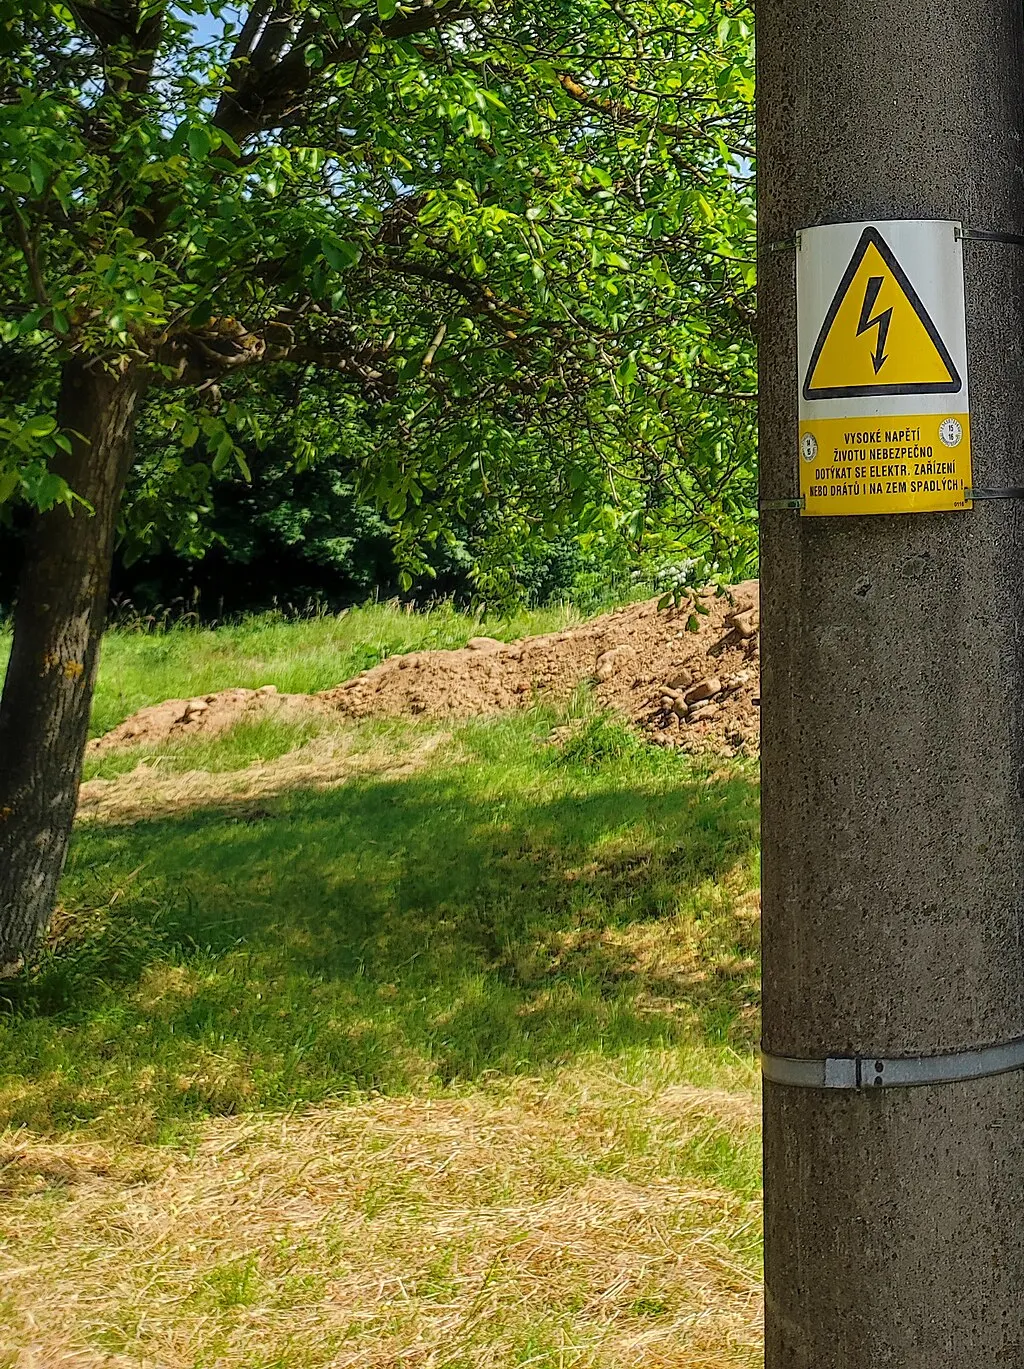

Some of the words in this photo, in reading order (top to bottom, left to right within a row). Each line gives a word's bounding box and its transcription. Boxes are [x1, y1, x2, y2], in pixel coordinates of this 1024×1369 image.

[844, 429, 881, 444] VYSOKÉ
[885, 427, 920, 442] NAPĚTÍ
[834, 448, 866, 462] ŽIVOTU
[870, 445, 933, 460] NEBEZPEČNO
[816, 466, 851, 480] DOTÝKAT
[855, 467, 866, 478] SE
[870, 464, 911, 478] ELEKTR.
[914, 459, 956, 476] ZAŘÍZENÍ
[810, 485, 828, 497] NEBO
[830, 481, 860, 496] DRÁTŮ
[863, 484, 866, 495] I
[869, 484, 883, 495] NA
[886, 482, 907, 494] ZEM
[910, 479, 958, 493] SPADLÝCH
